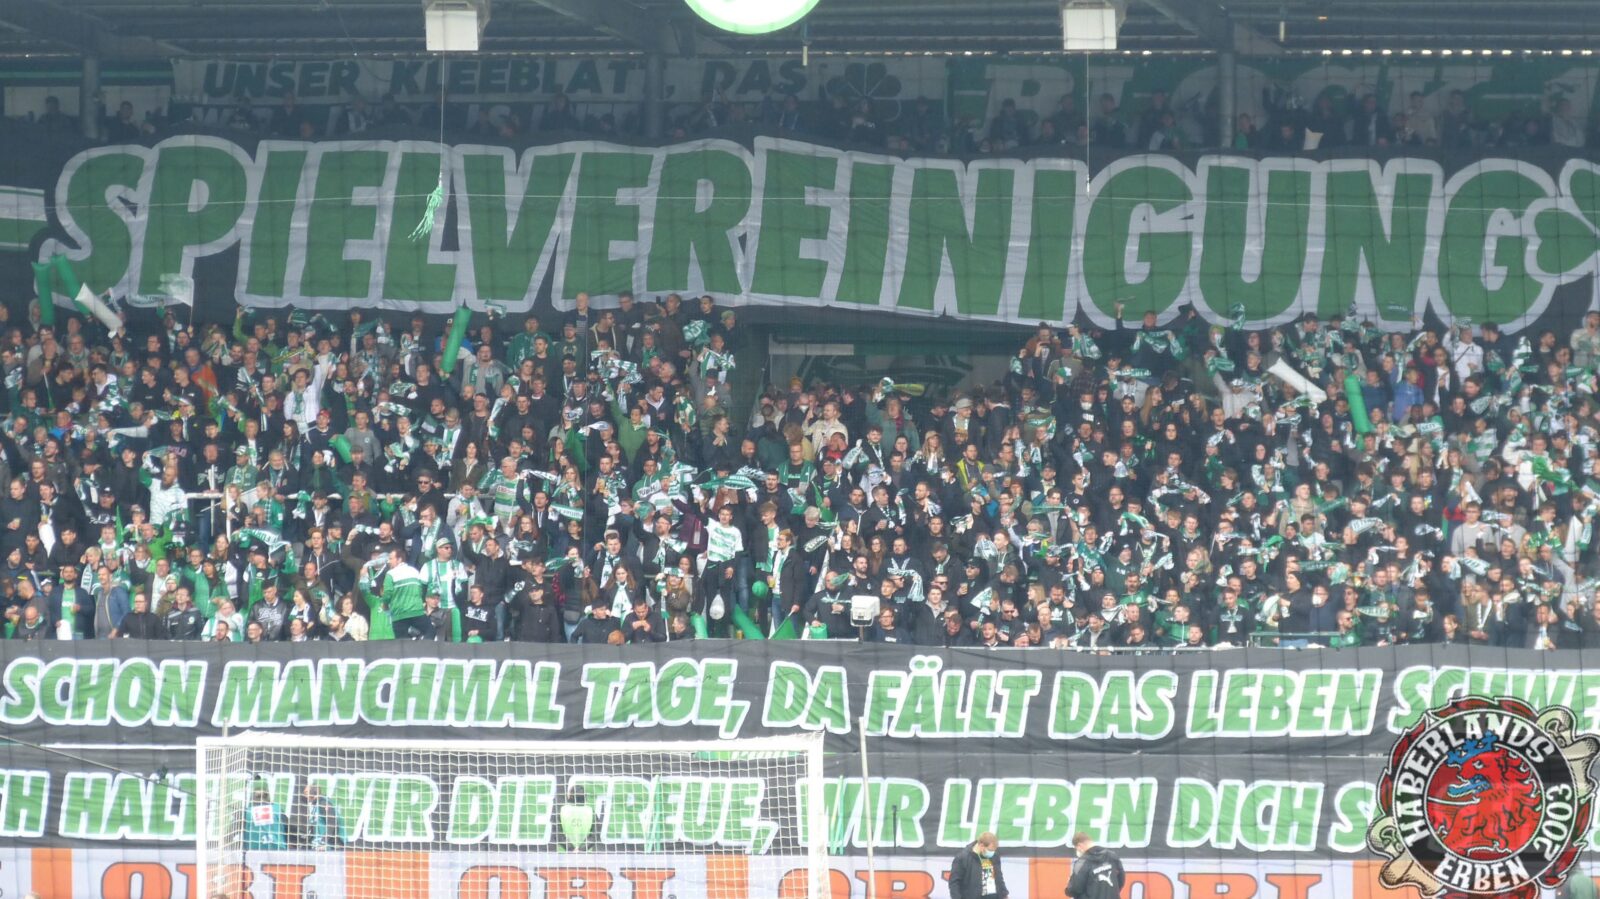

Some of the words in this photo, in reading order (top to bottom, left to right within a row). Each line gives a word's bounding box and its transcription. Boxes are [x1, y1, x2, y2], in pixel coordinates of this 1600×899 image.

[204, 59, 361, 98] UNSER
[701, 58, 808, 97] DAS
[35, 134, 1560, 336] SPIELVEREINIGUNG
[0, 657, 208, 727] SCHON
[211, 658, 566, 730] MANCHMAL
[580, 657, 751, 740] TAGE,
[761, 660, 851, 735] DA
[863, 655, 1043, 739] FÄLLT
[1047, 669, 1179, 739] DAS
[1186, 666, 1383, 738] LEBEN
[0, 768, 50, 837] H
[446, 774, 556, 845] DIE
[936, 777, 1158, 849] LIEBEN
[1165, 778, 1324, 852] DICH
